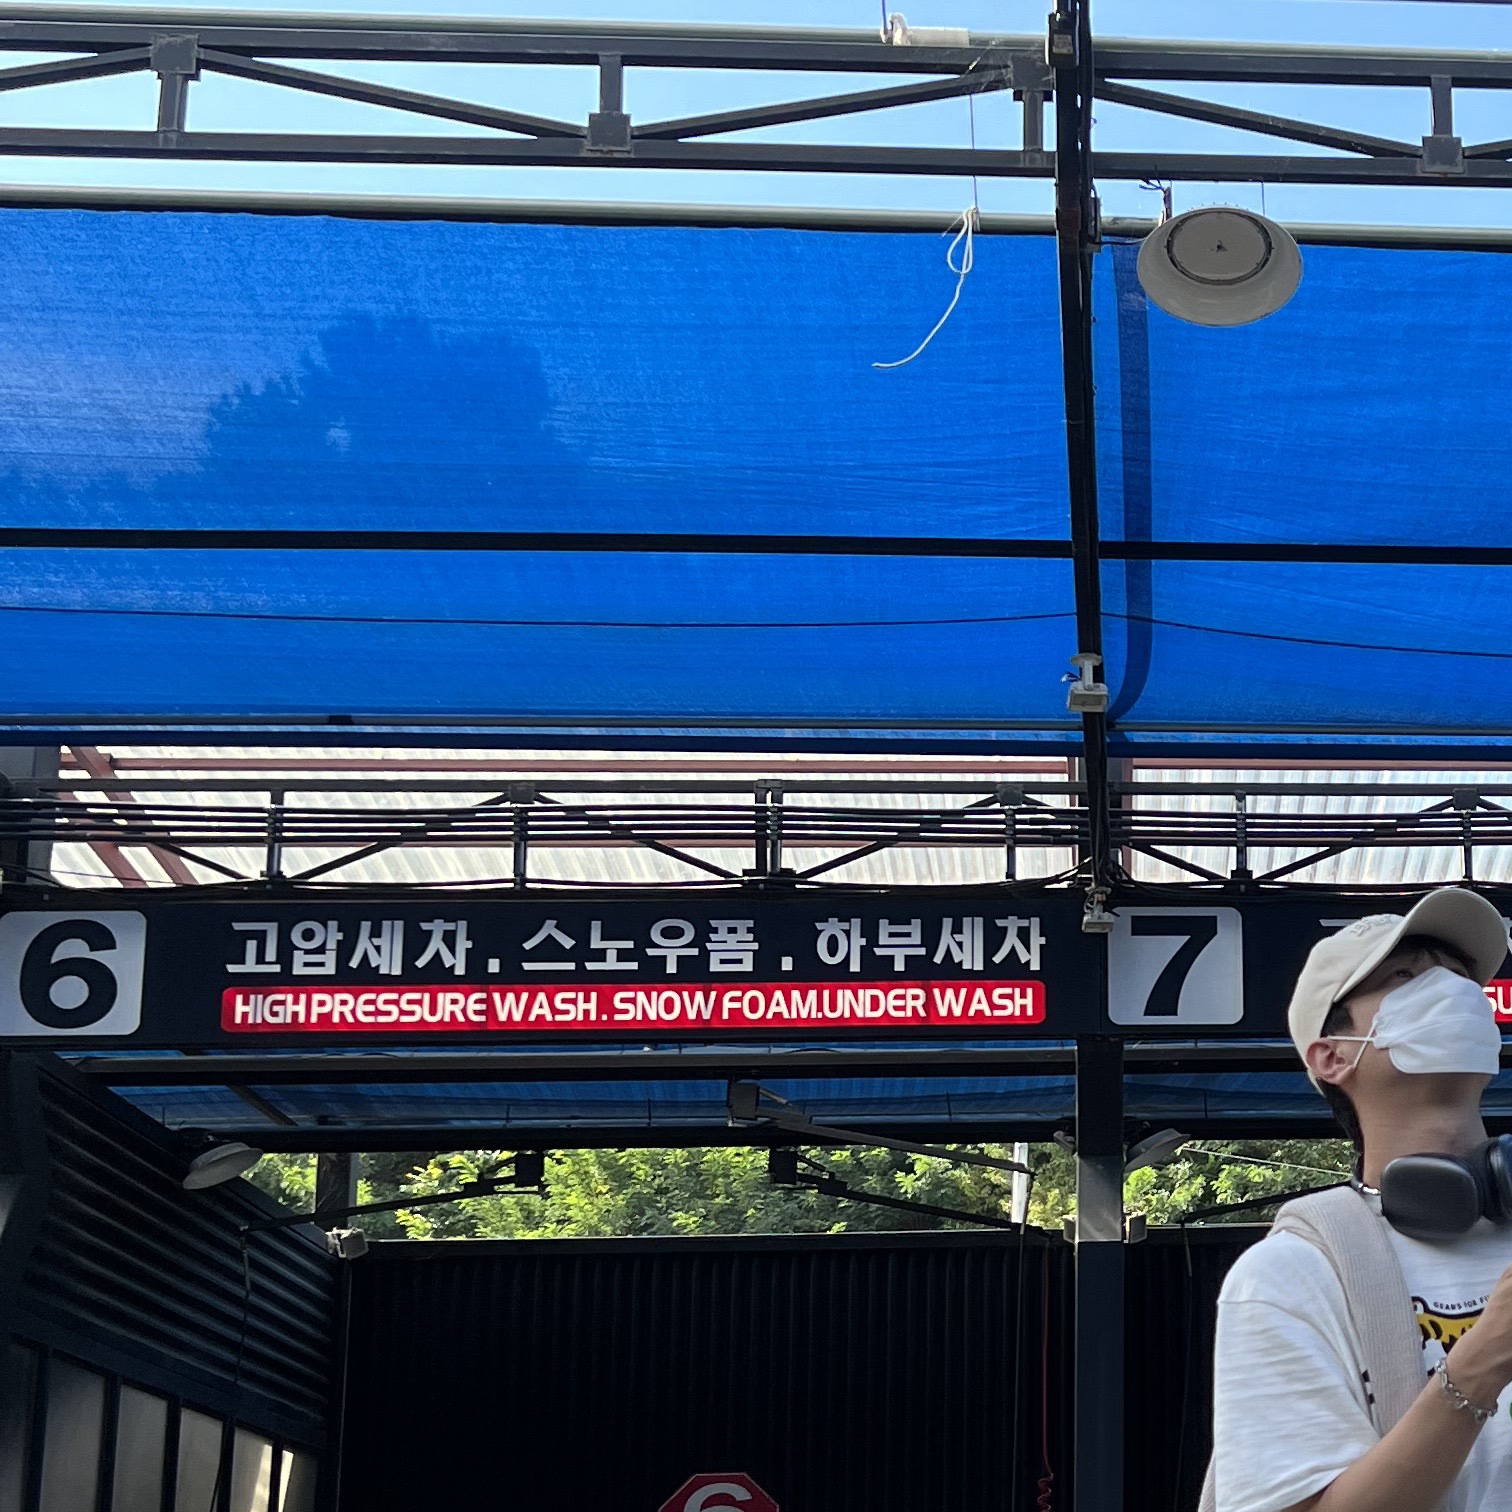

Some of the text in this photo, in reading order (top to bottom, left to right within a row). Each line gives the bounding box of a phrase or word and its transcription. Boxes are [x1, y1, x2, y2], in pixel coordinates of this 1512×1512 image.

[19, 919, 118, 1029] 6
[815, 916, 1045, 972] 하부세차
[1130, 915, 1218, 1017] 7
[933, 987, 1034, 1017] WASH
